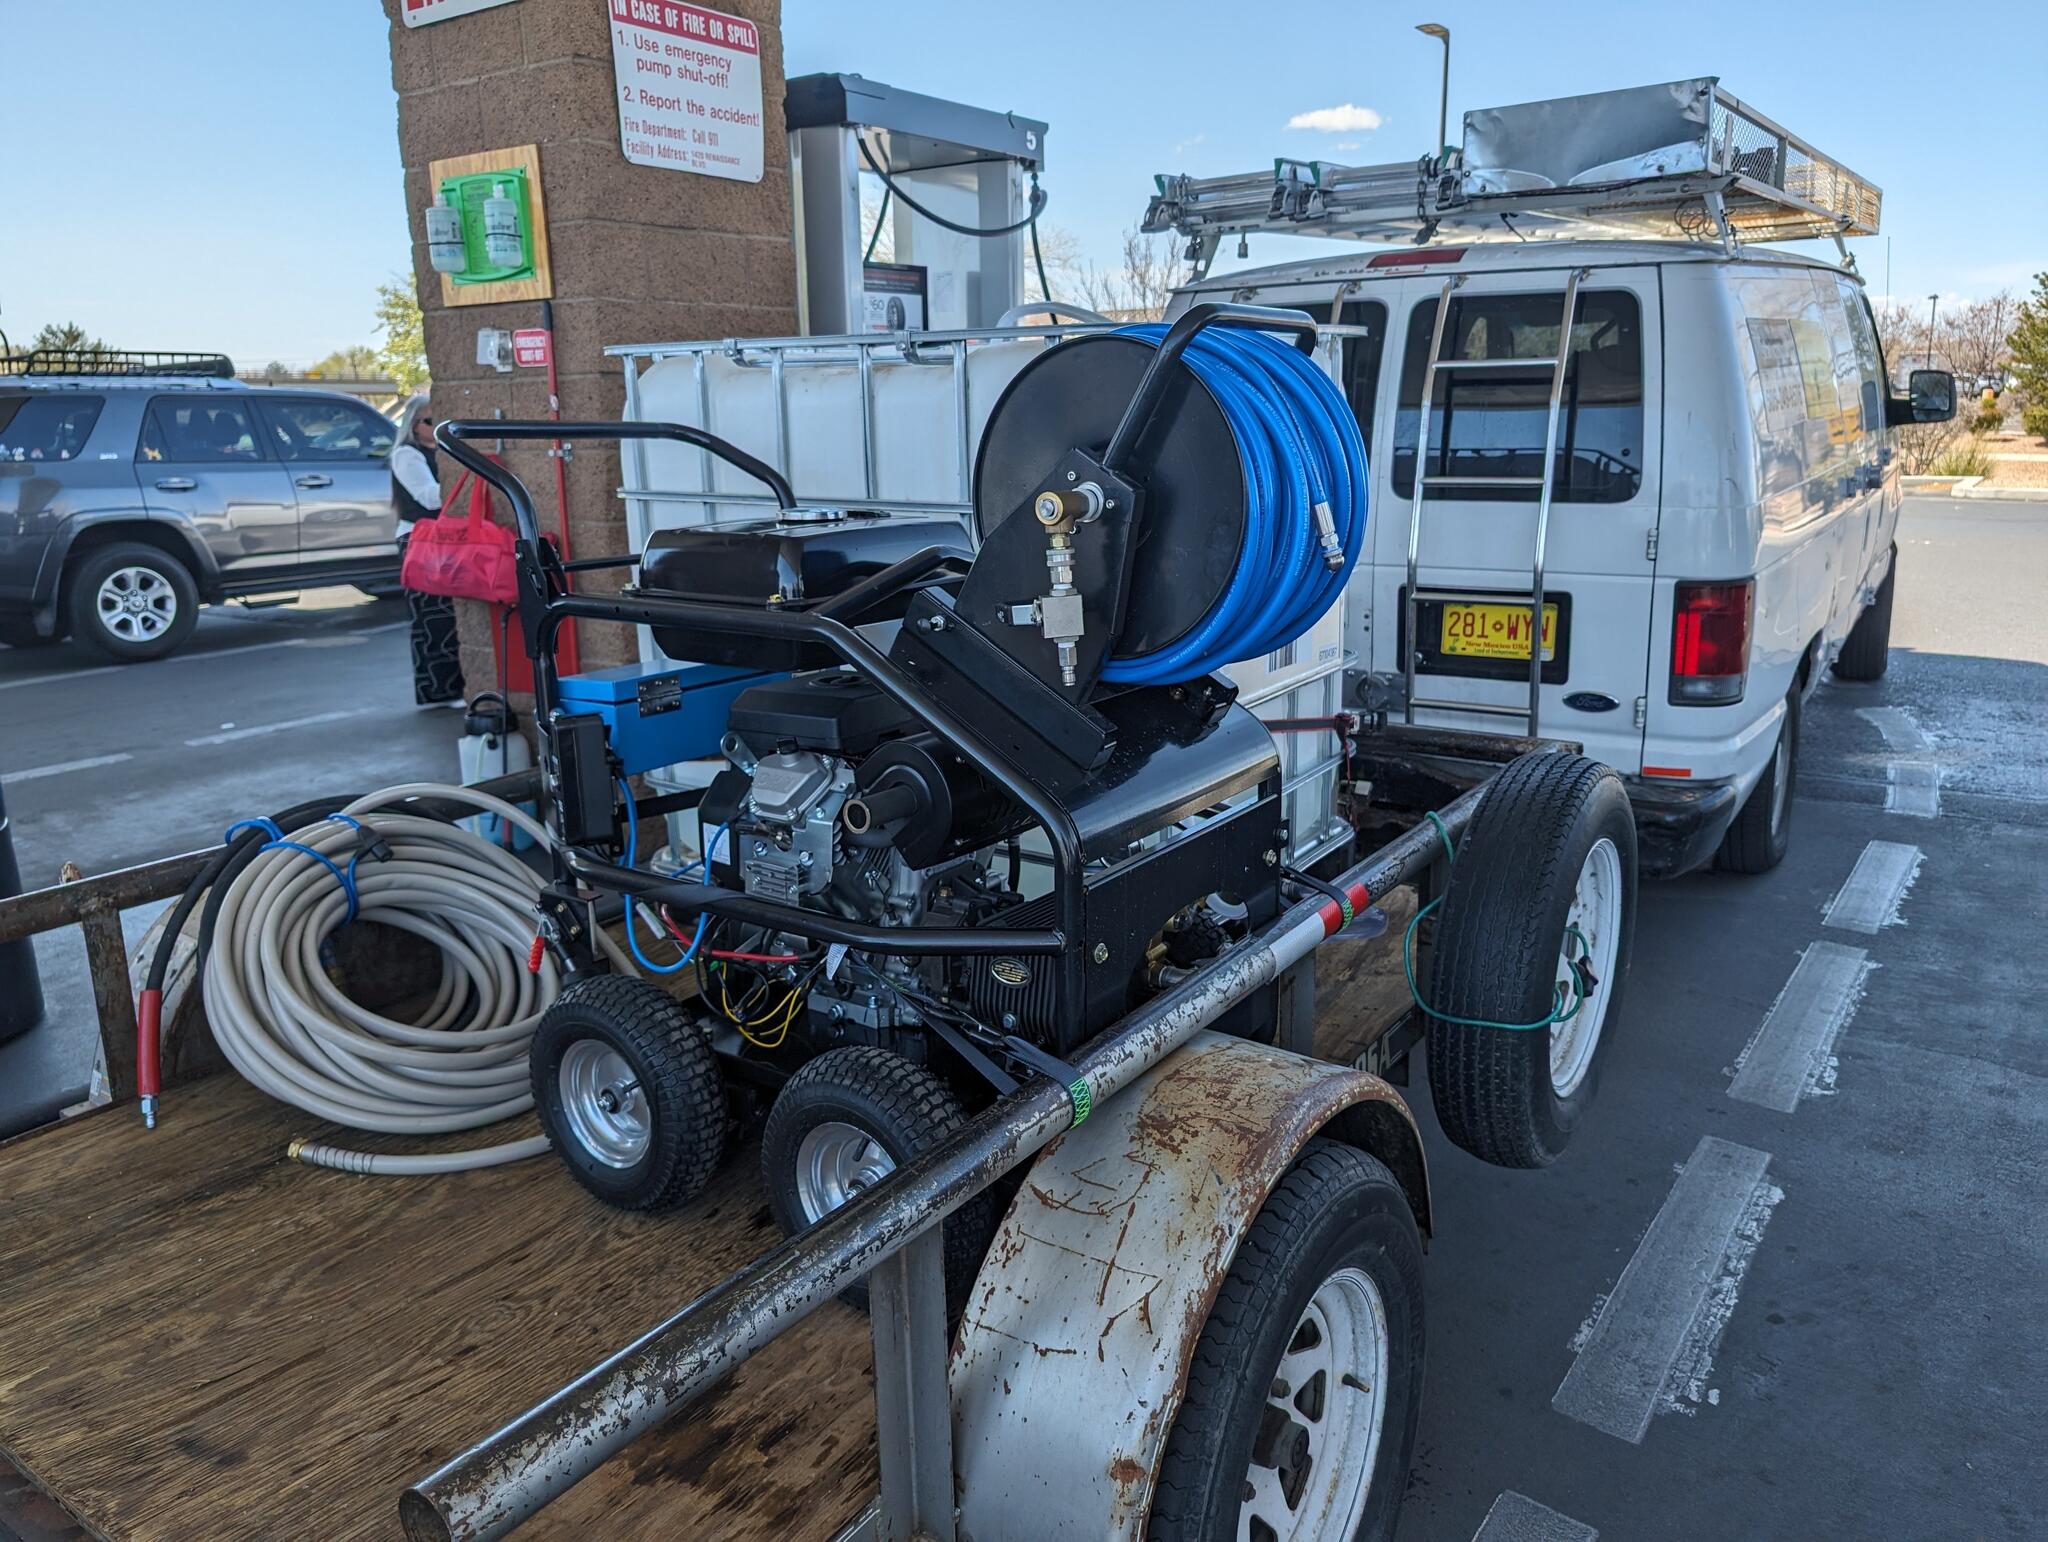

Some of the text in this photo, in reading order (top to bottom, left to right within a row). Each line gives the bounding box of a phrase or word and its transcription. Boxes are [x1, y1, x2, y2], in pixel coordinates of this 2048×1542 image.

[613, 0, 756, 48] IN CASE OF FIRE OR SPILL
[617, 30, 732, 73] 1. Use emergency
[636, 58, 729, 89] pump shut-off!
[623, 85, 760, 127] 2. Report the accident!
[624, 116, 640, 133] Fire
[642, 119, 687, 141] Department:
[692, 128, 706, 145] Call
[1026, 131, 1037, 151] 5
[626, 138, 654, 159] Facility
[657, 143, 689, 162] Address:
[1448, 611, 1488, 639] 281
